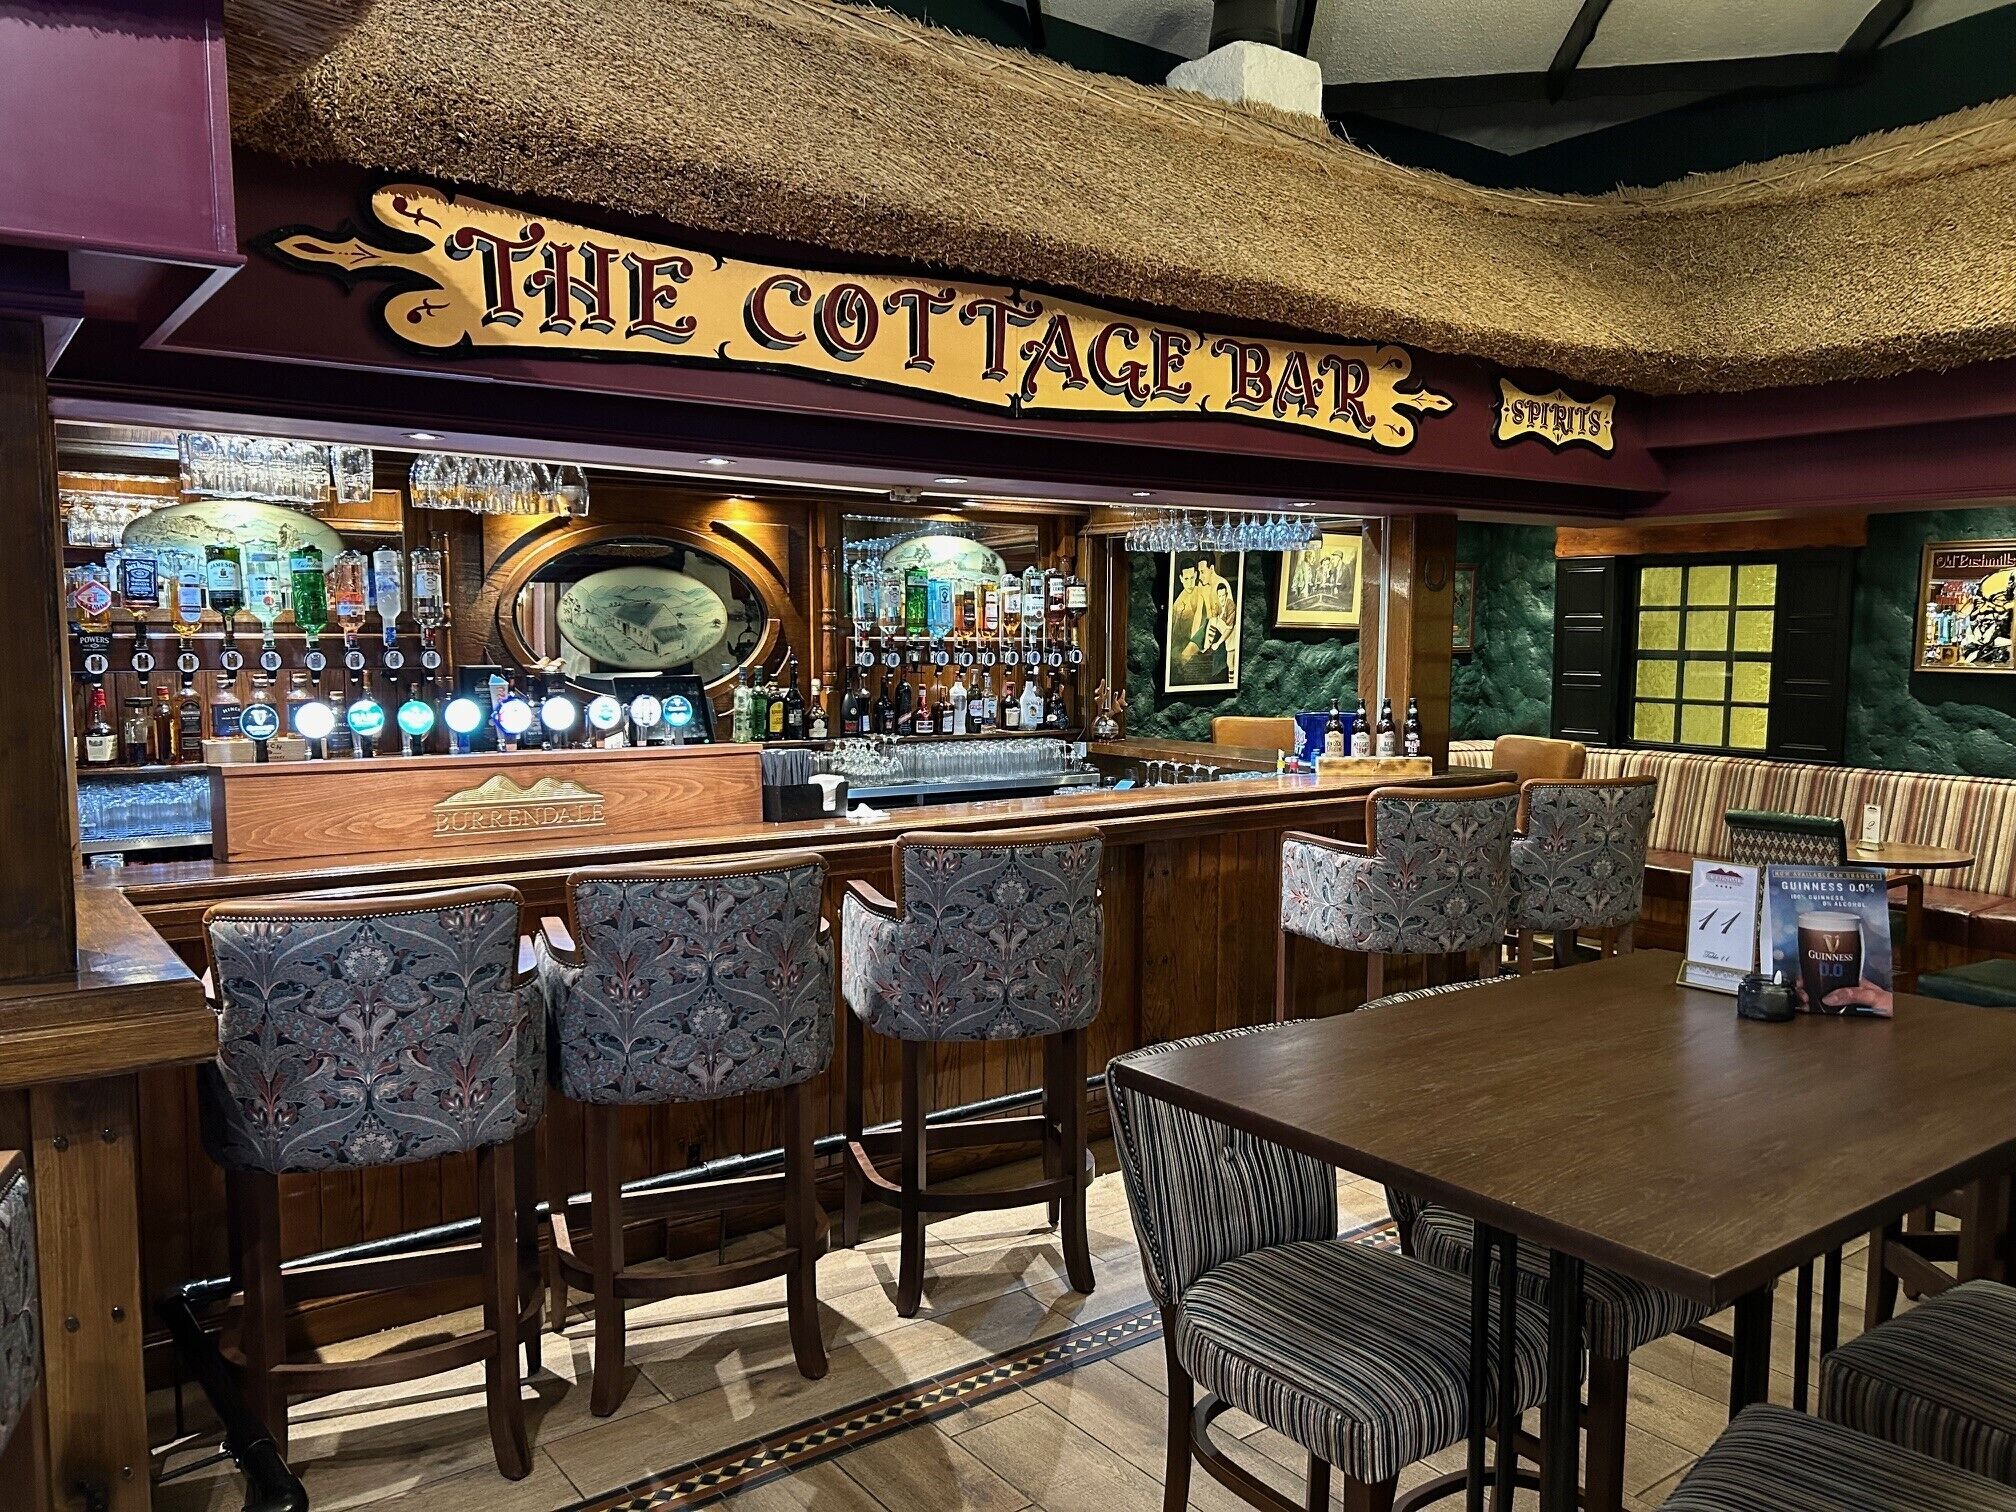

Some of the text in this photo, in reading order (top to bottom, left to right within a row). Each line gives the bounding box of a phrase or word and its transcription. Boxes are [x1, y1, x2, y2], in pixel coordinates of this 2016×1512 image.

[445, 222, 1376, 432] THE COTTAGE BAR
[1511, 399, 1602, 436] SPIRITS
[209, 562, 236, 570] JAMESON
[80, 636, 110, 644] POWERS
[434, 804, 606, 832] BURRENDALE
[1781, 881, 1875, 893] GUINNESS 0.0%
[1808, 949, 1854, 962] GUINNESS
